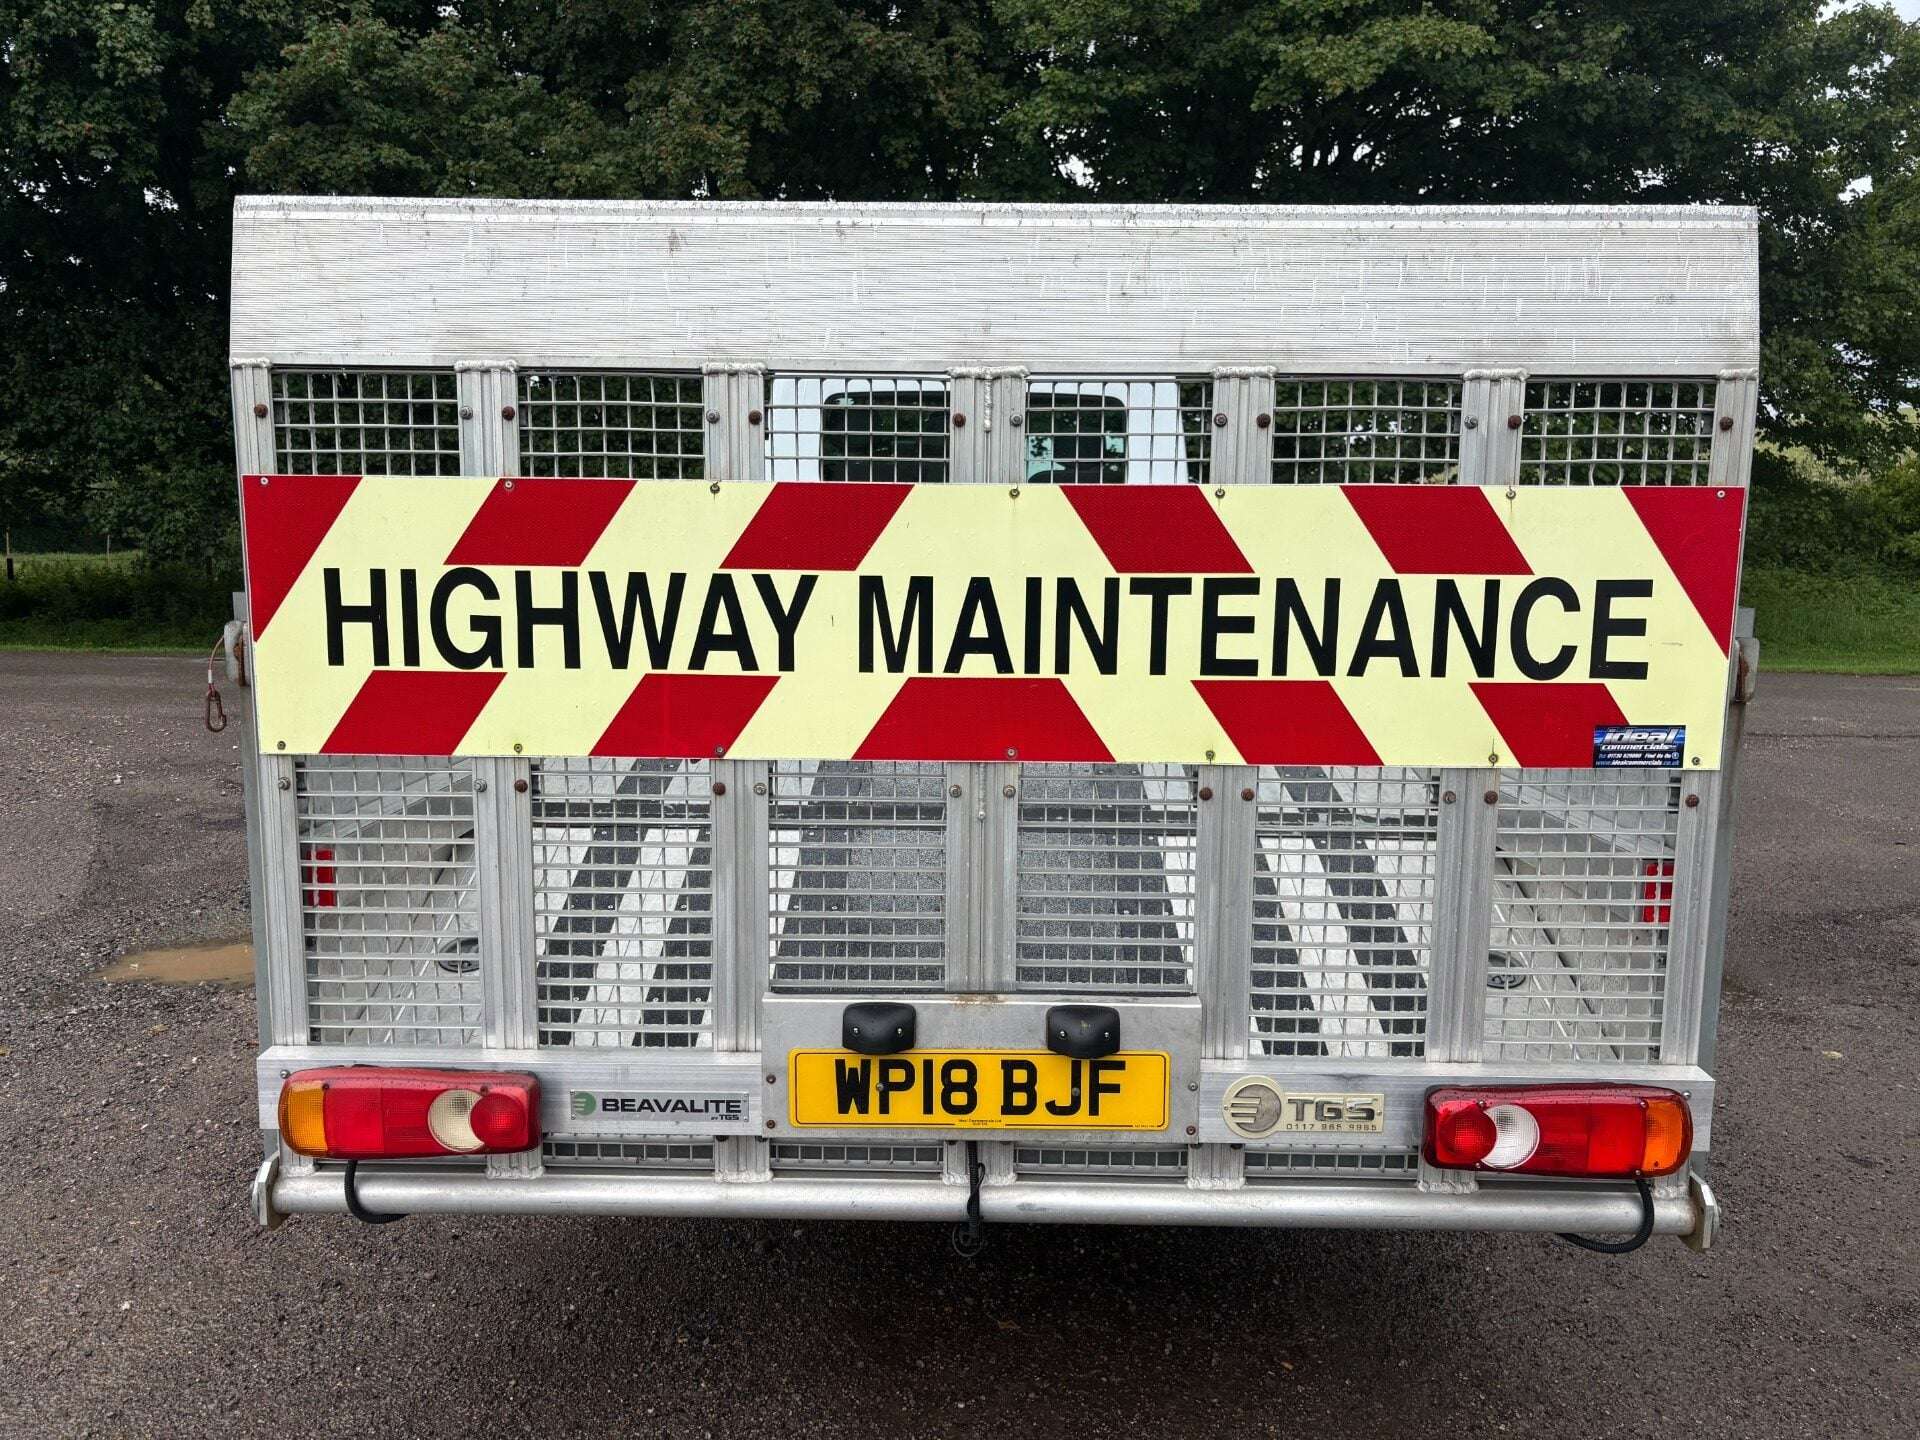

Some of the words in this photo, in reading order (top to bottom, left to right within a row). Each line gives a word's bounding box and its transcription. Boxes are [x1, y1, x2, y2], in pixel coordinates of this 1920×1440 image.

[323, 566, 818, 673] HIGHWAY
[858, 575, 1654, 681] MAINTENANCE
[1603, 727, 1680, 744] ideal
[834, 1059, 978, 1116] WP18
[1000, 1060, 1126, 1117] BJF
[602, 1098, 742, 1114] BEAVALITE
[1287, 1096, 1377, 1122] TGS
[1286, 1123, 1314, 1131] 0117
